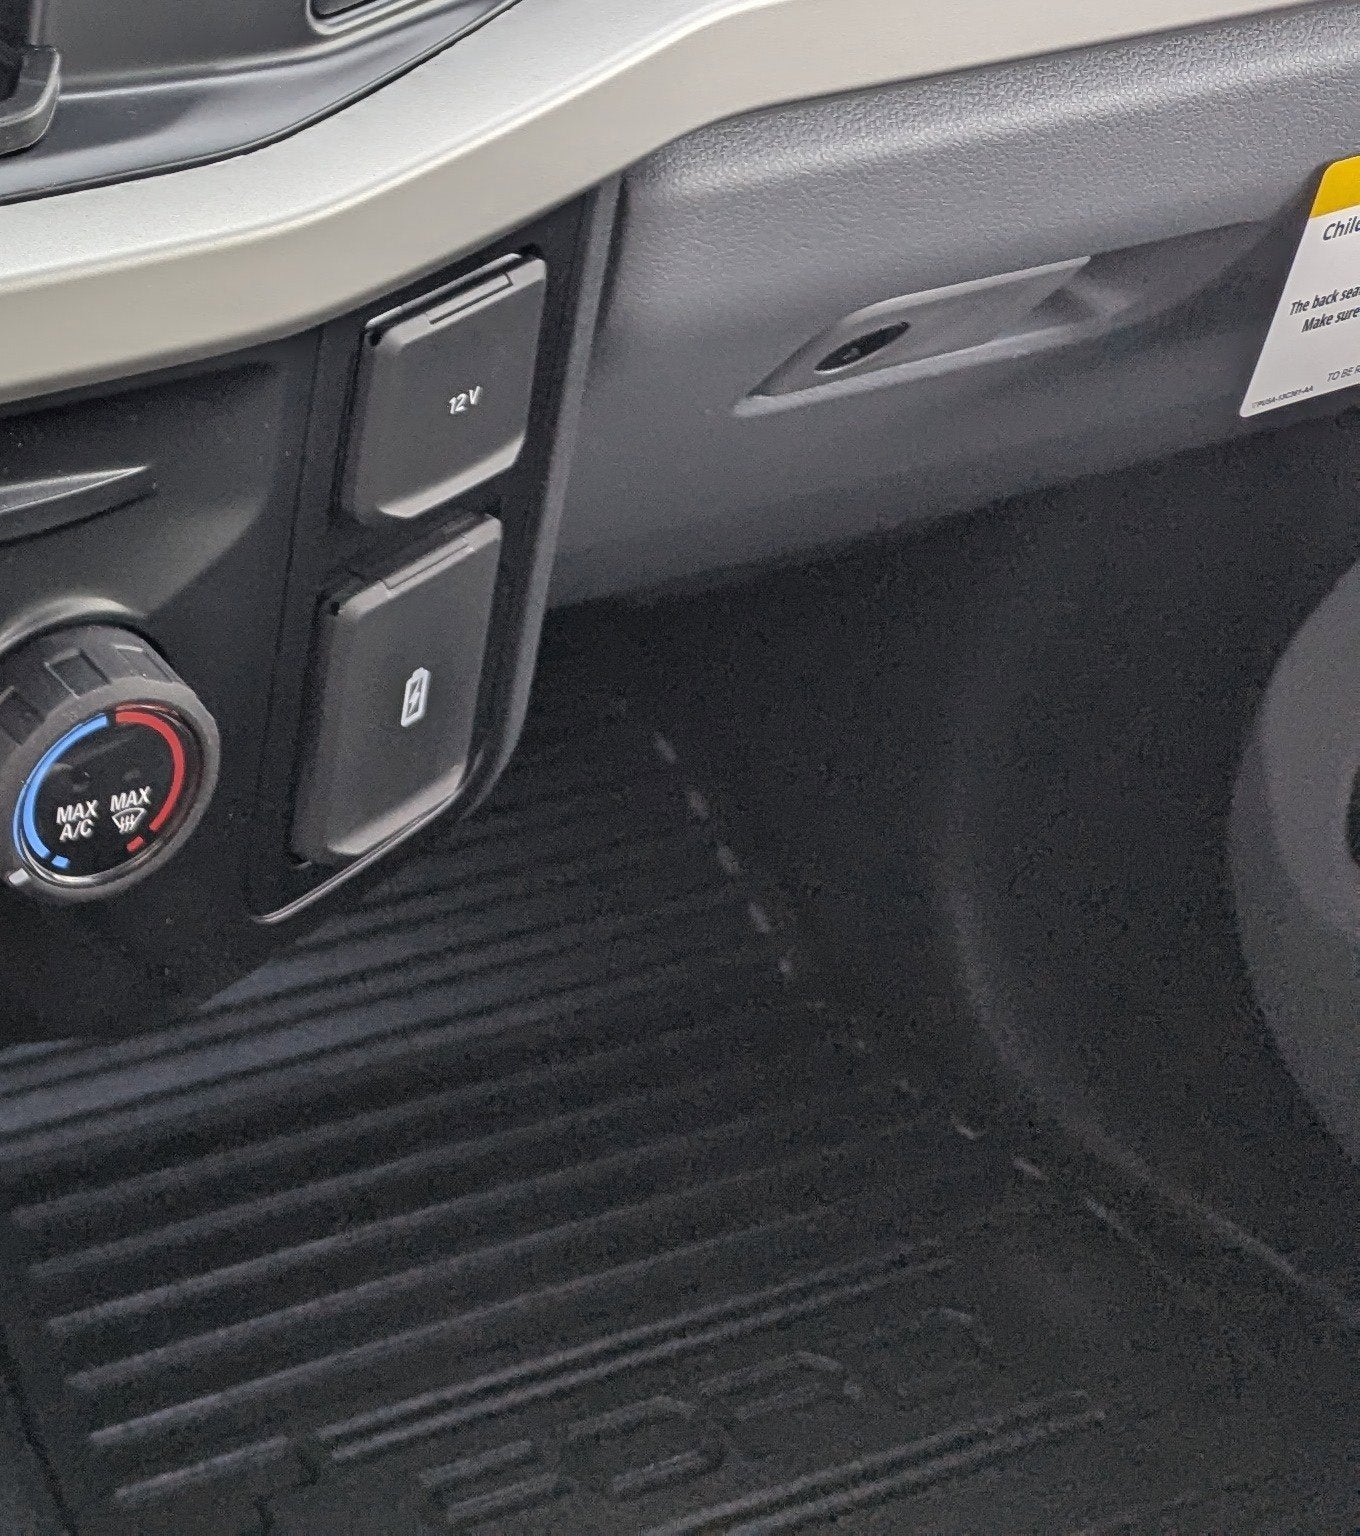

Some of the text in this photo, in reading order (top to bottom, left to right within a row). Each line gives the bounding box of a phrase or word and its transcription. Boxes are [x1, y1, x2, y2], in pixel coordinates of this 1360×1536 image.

[1289, 299, 1311, 316] The
[1311, 288, 1340, 309] back
[1301, 313, 1334, 333] Make
[55, 798, 99, 825] MAX
[110, 785, 152, 813] MAX
[59, 818, 95, 843] A/C
